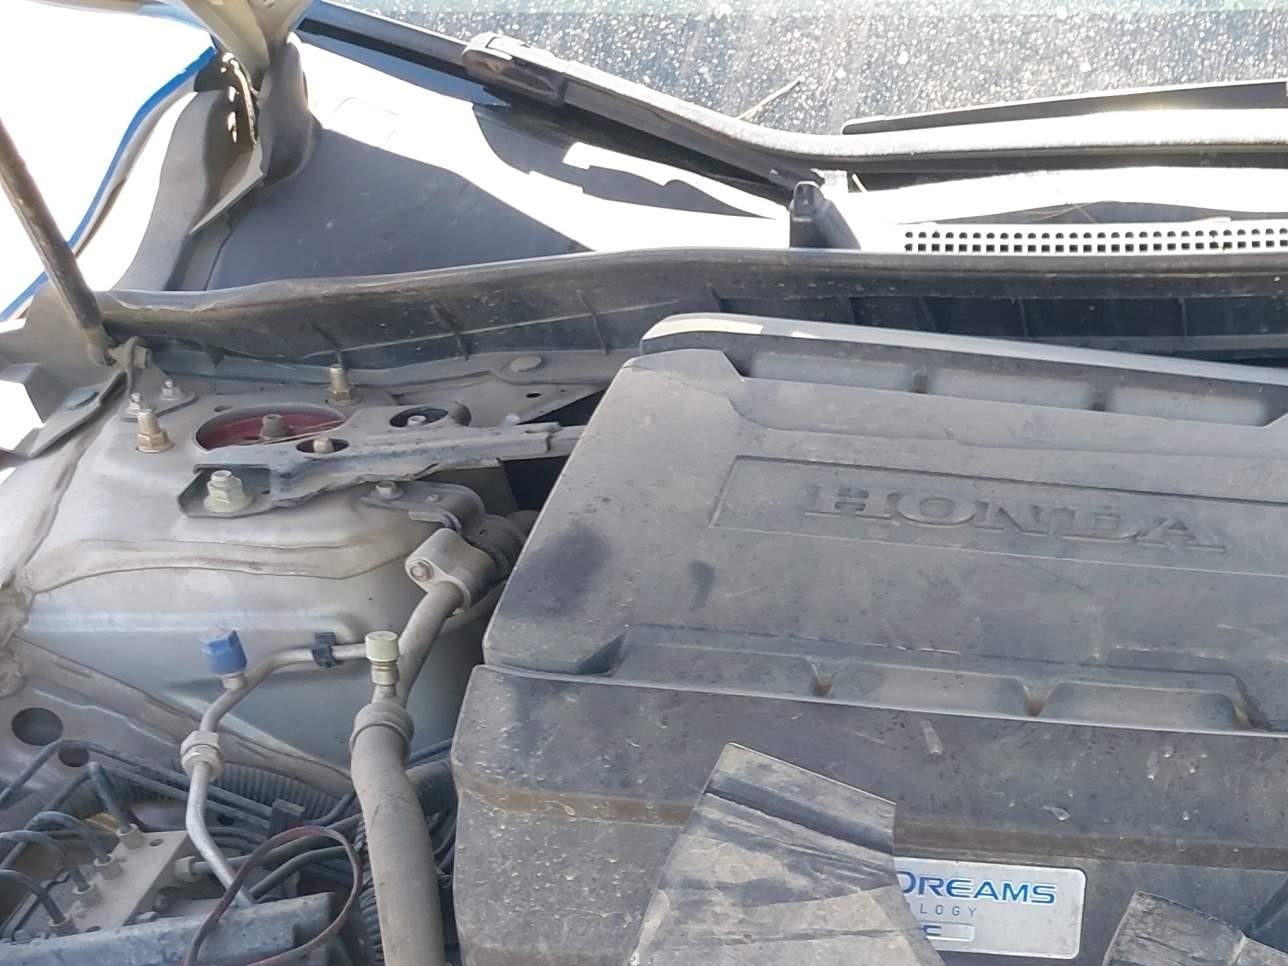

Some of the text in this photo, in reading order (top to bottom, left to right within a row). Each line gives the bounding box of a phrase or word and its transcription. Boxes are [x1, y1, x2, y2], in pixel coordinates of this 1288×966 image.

[804, 484, 1227, 553] HONDA
[896, 870, 1056, 904] DREAMS
[919, 903, 977, 918] LOGY
